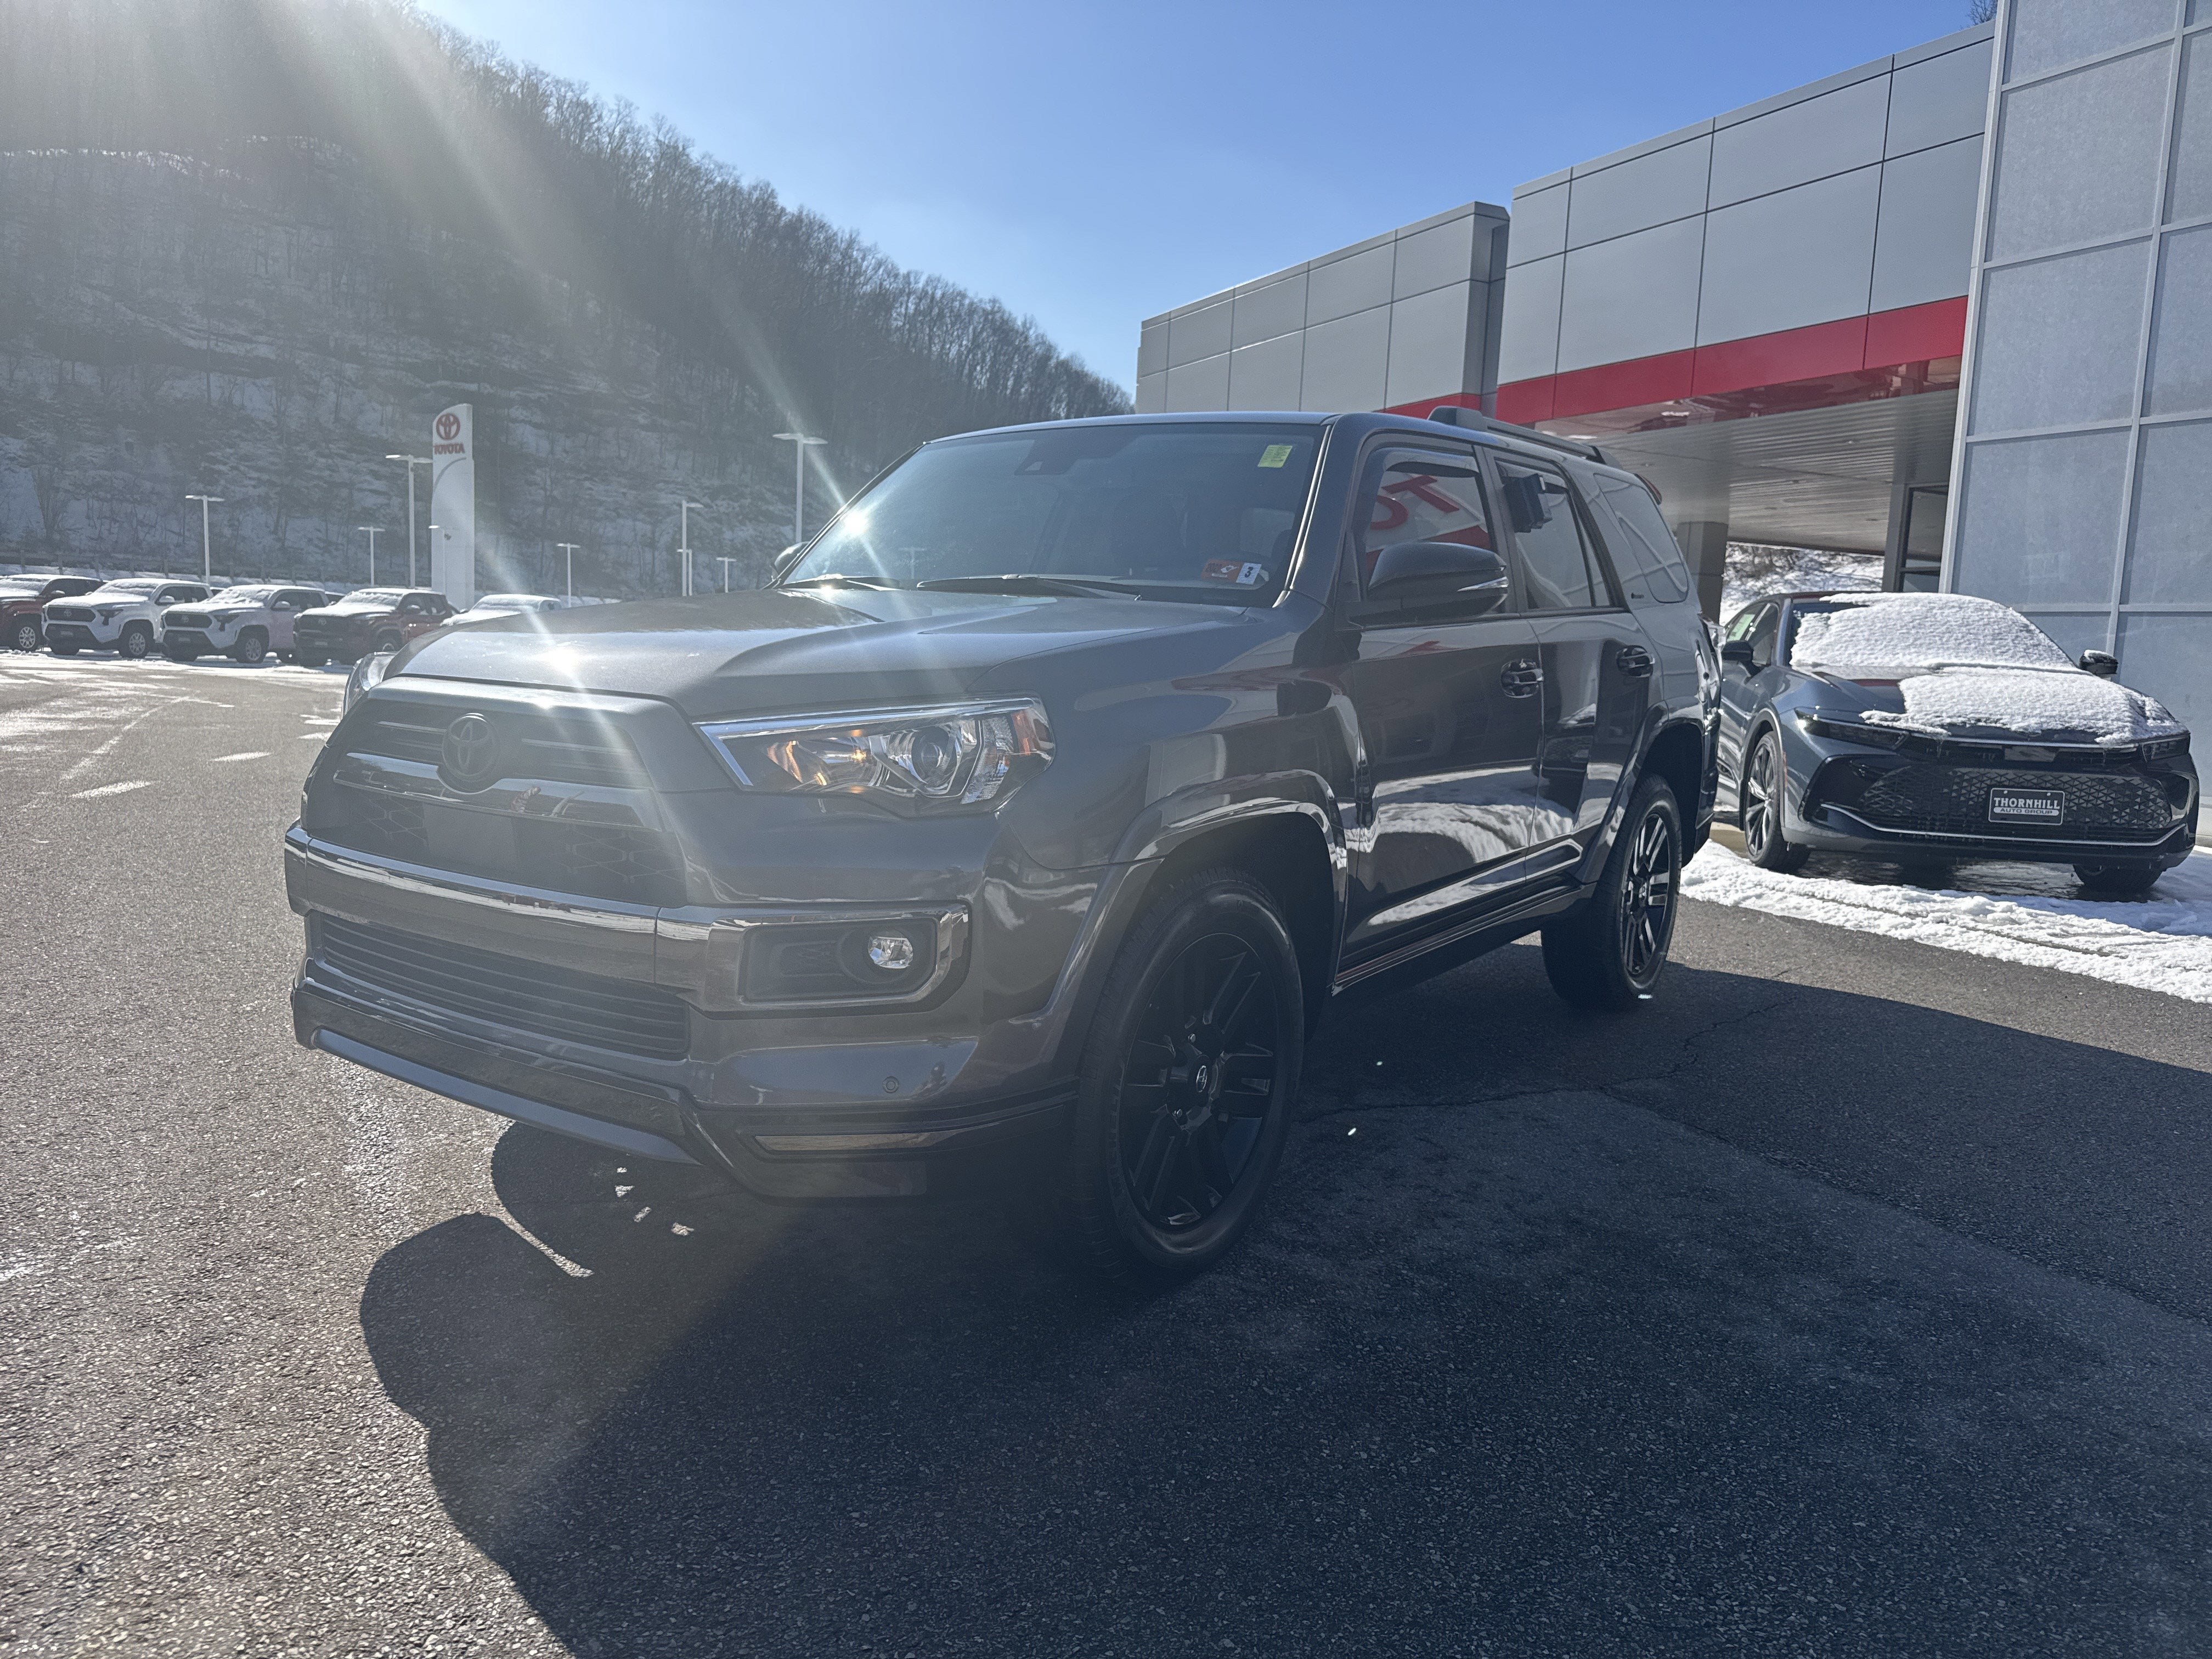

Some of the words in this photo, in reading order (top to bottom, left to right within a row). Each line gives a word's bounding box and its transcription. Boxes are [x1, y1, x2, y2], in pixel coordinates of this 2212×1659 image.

[433, 443, 465, 455] TOYOTA
[1244, 567, 1254, 578] 3
[1994, 797, 2060, 809] THORNHILL
